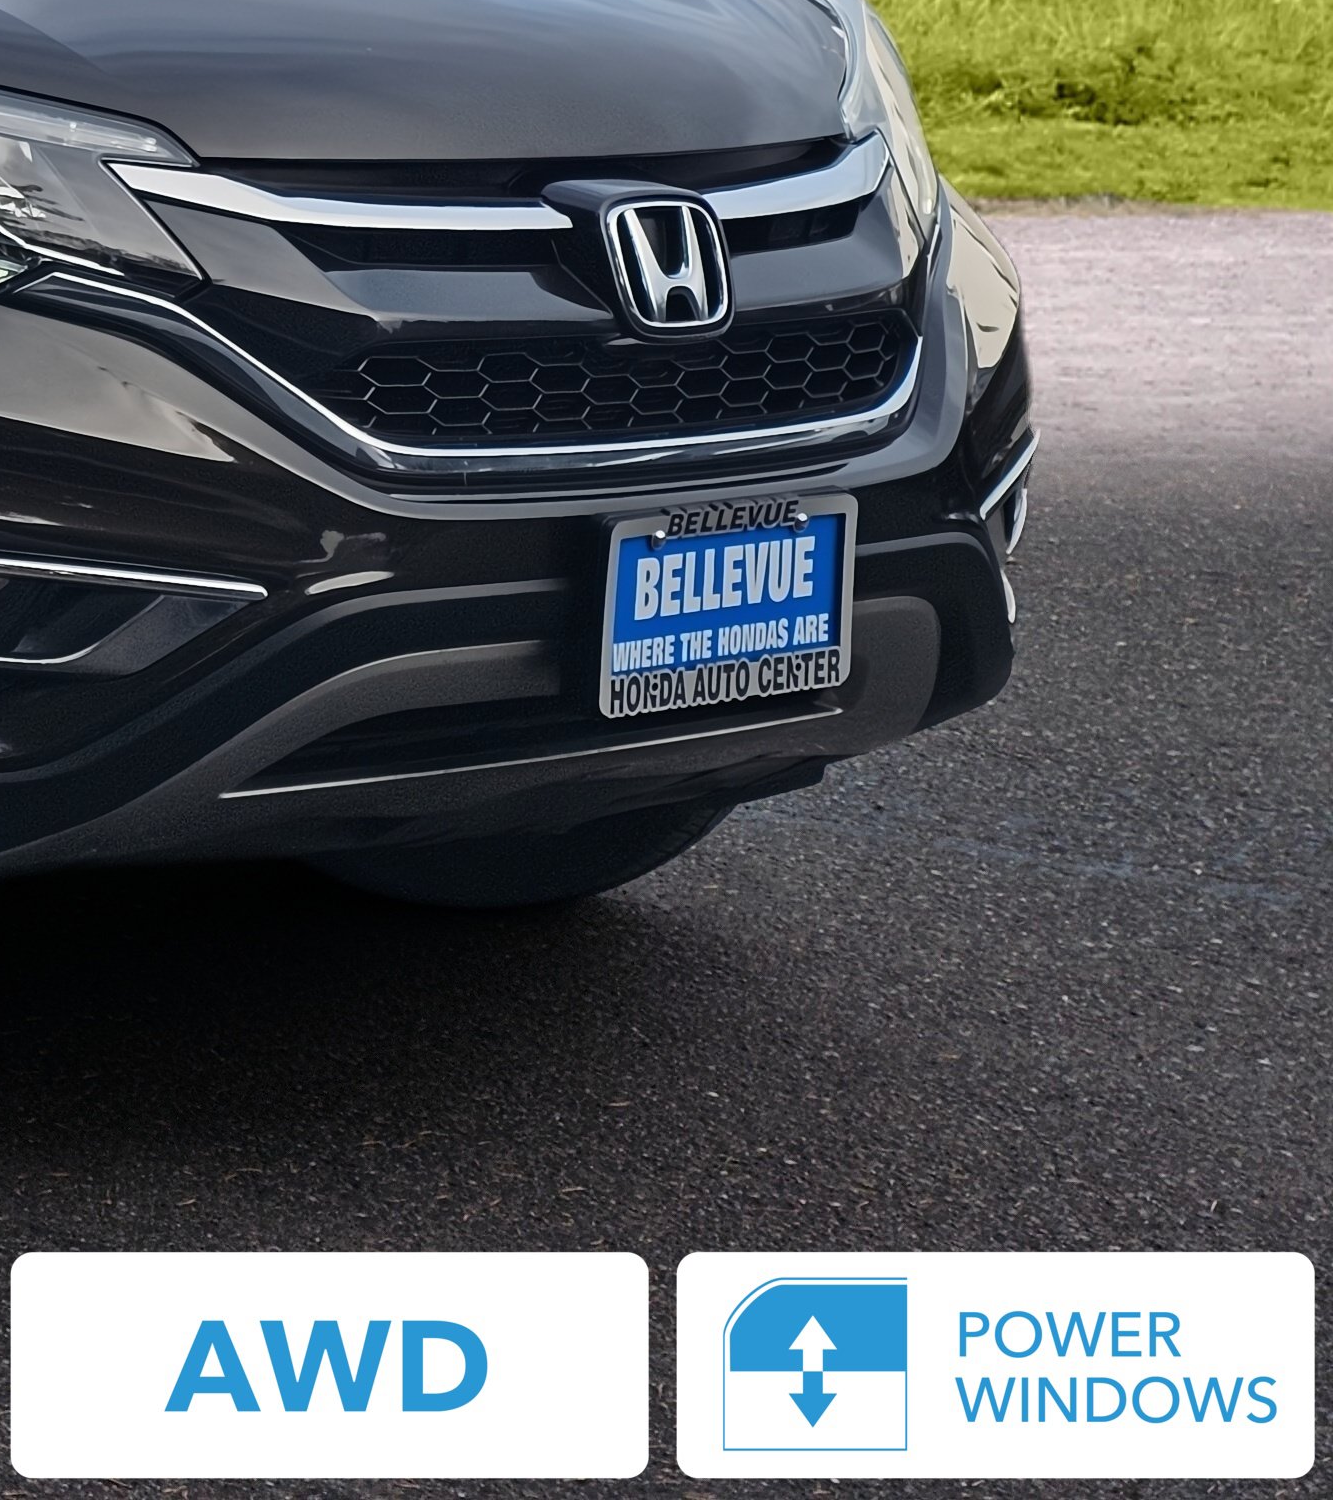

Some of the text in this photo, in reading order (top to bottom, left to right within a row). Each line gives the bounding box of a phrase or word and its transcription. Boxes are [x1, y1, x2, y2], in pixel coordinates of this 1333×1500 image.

[667, 499, 799, 537] BELLEVUE
[633, 535, 816, 621] BELLEVUE
[612, 613, 829, 673] WHERE THE HONDAS ARE
[610, 649, 841, 716] HONDA AUTO CENTER
